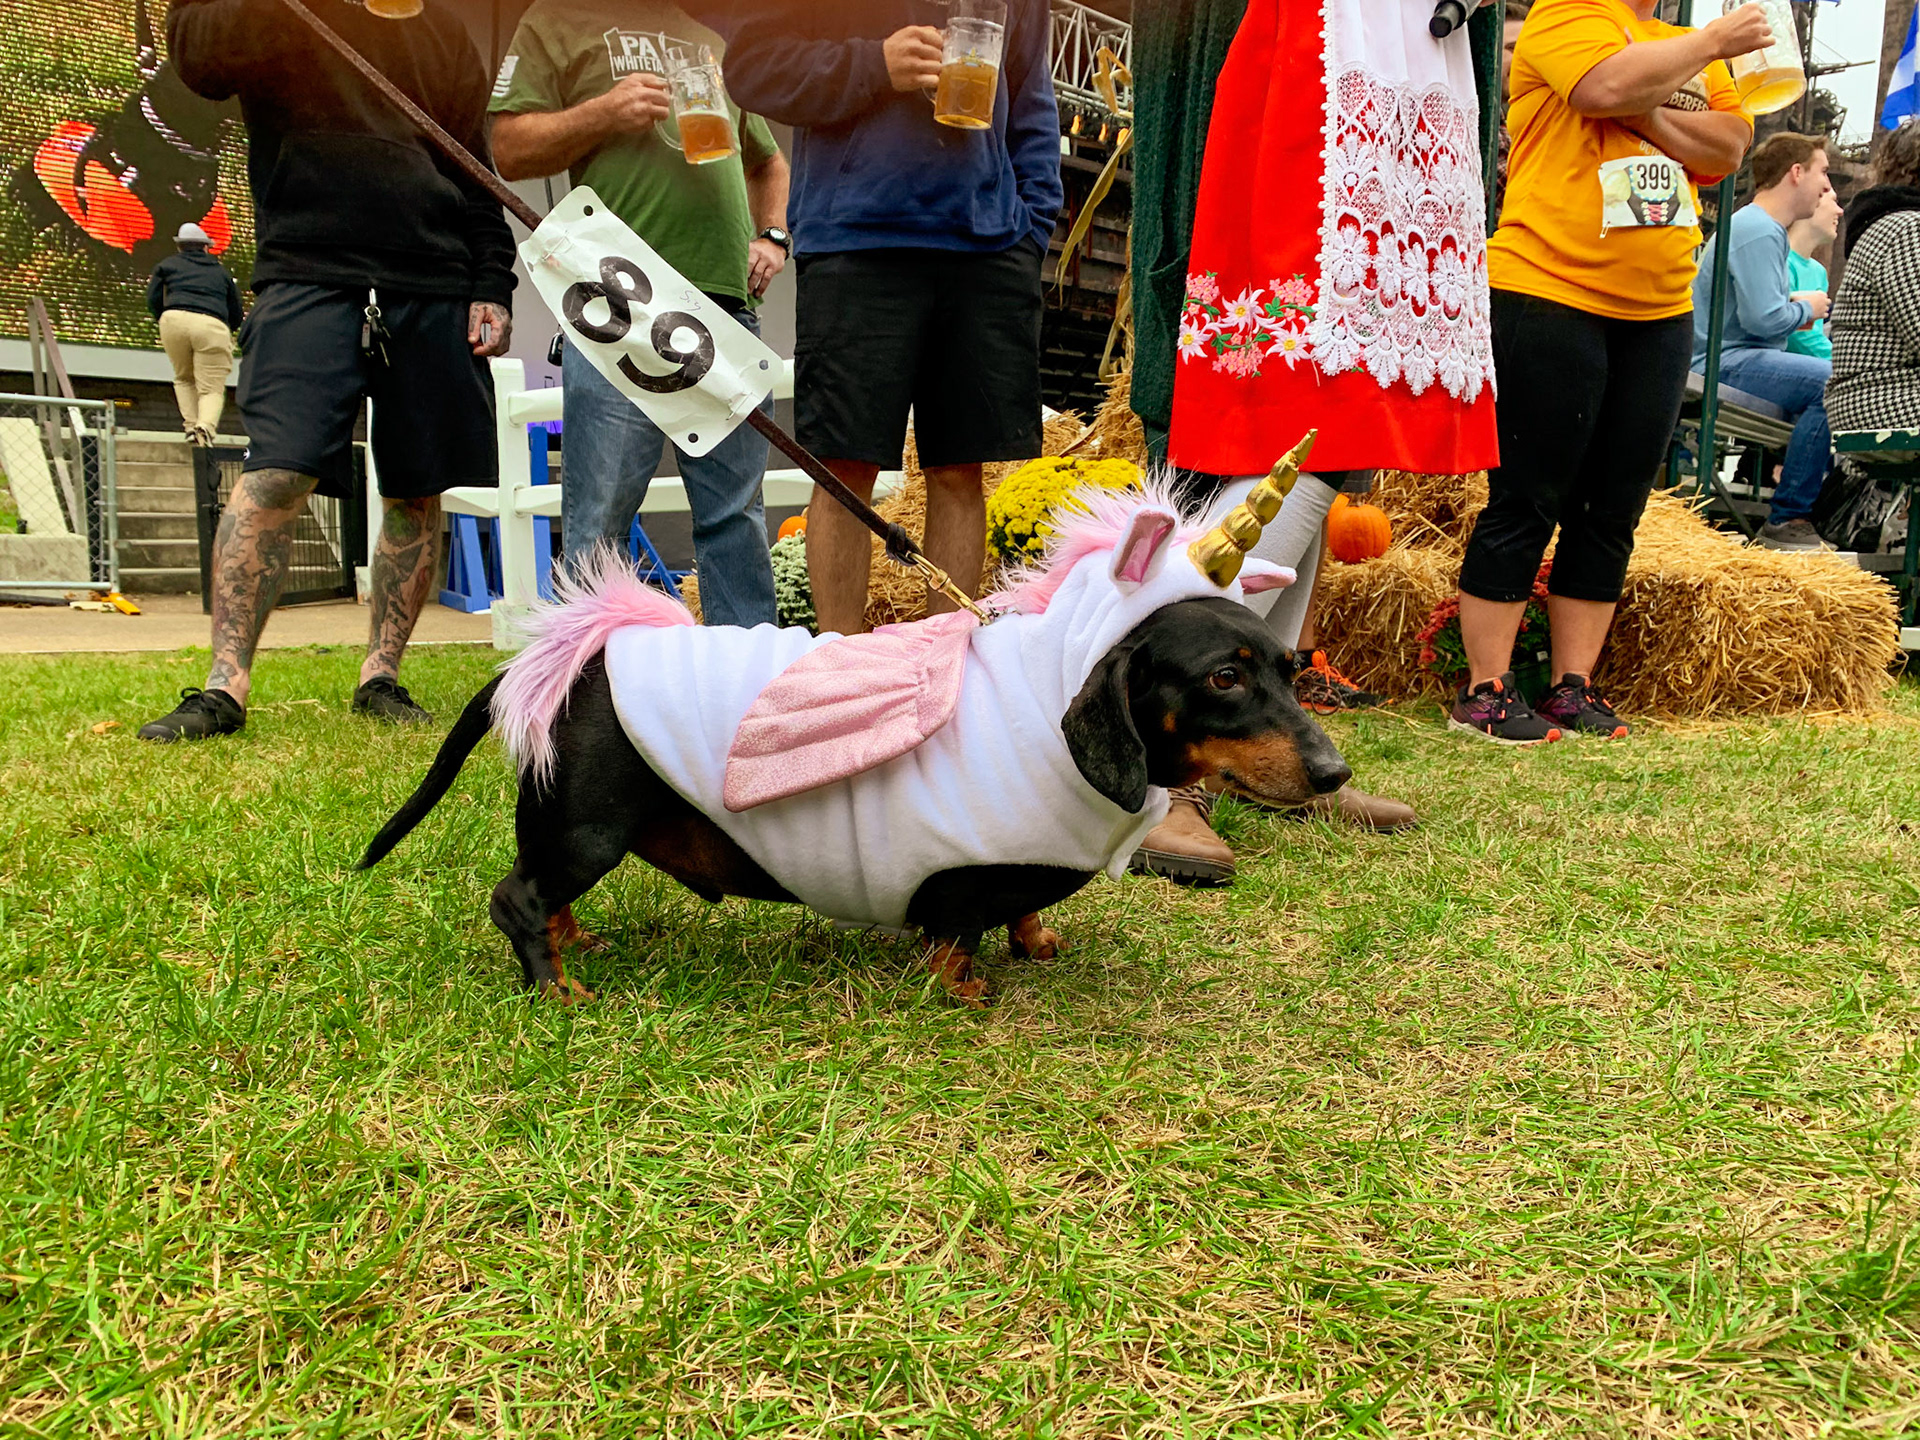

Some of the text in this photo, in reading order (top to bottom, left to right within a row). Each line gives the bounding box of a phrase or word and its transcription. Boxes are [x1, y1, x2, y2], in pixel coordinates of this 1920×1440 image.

[619, 36, 659, 58] PA
[613, 55, 665, 74] WHITETA
[1637, 163, 1670, 190] 399
[562, 256, 715, 393] 89
